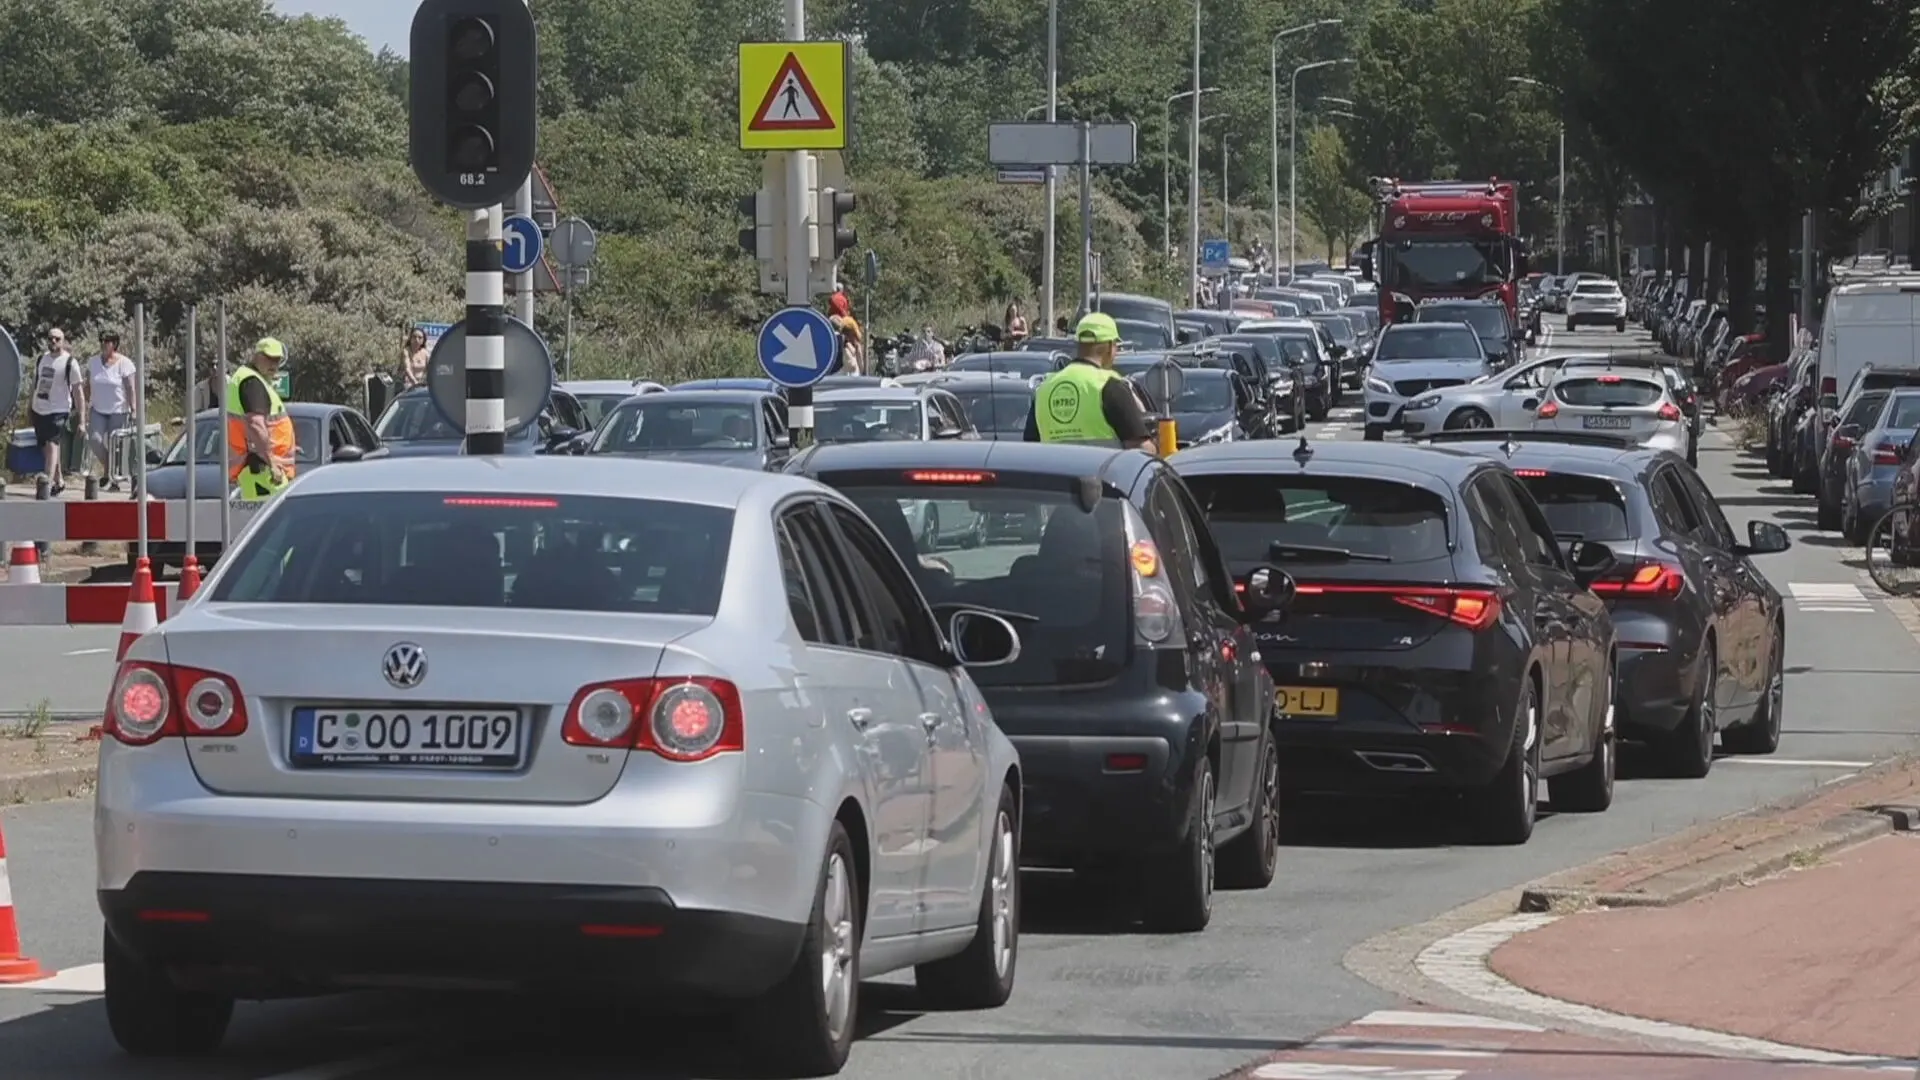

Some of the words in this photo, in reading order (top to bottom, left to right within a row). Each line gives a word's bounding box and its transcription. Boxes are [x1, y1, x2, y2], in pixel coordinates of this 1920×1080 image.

[460, 173, 485, 185] 68.2
[299, 736, 309, 748] D
[317, 714, 338, 749] C
[421, 715, 512, 749] 1009
